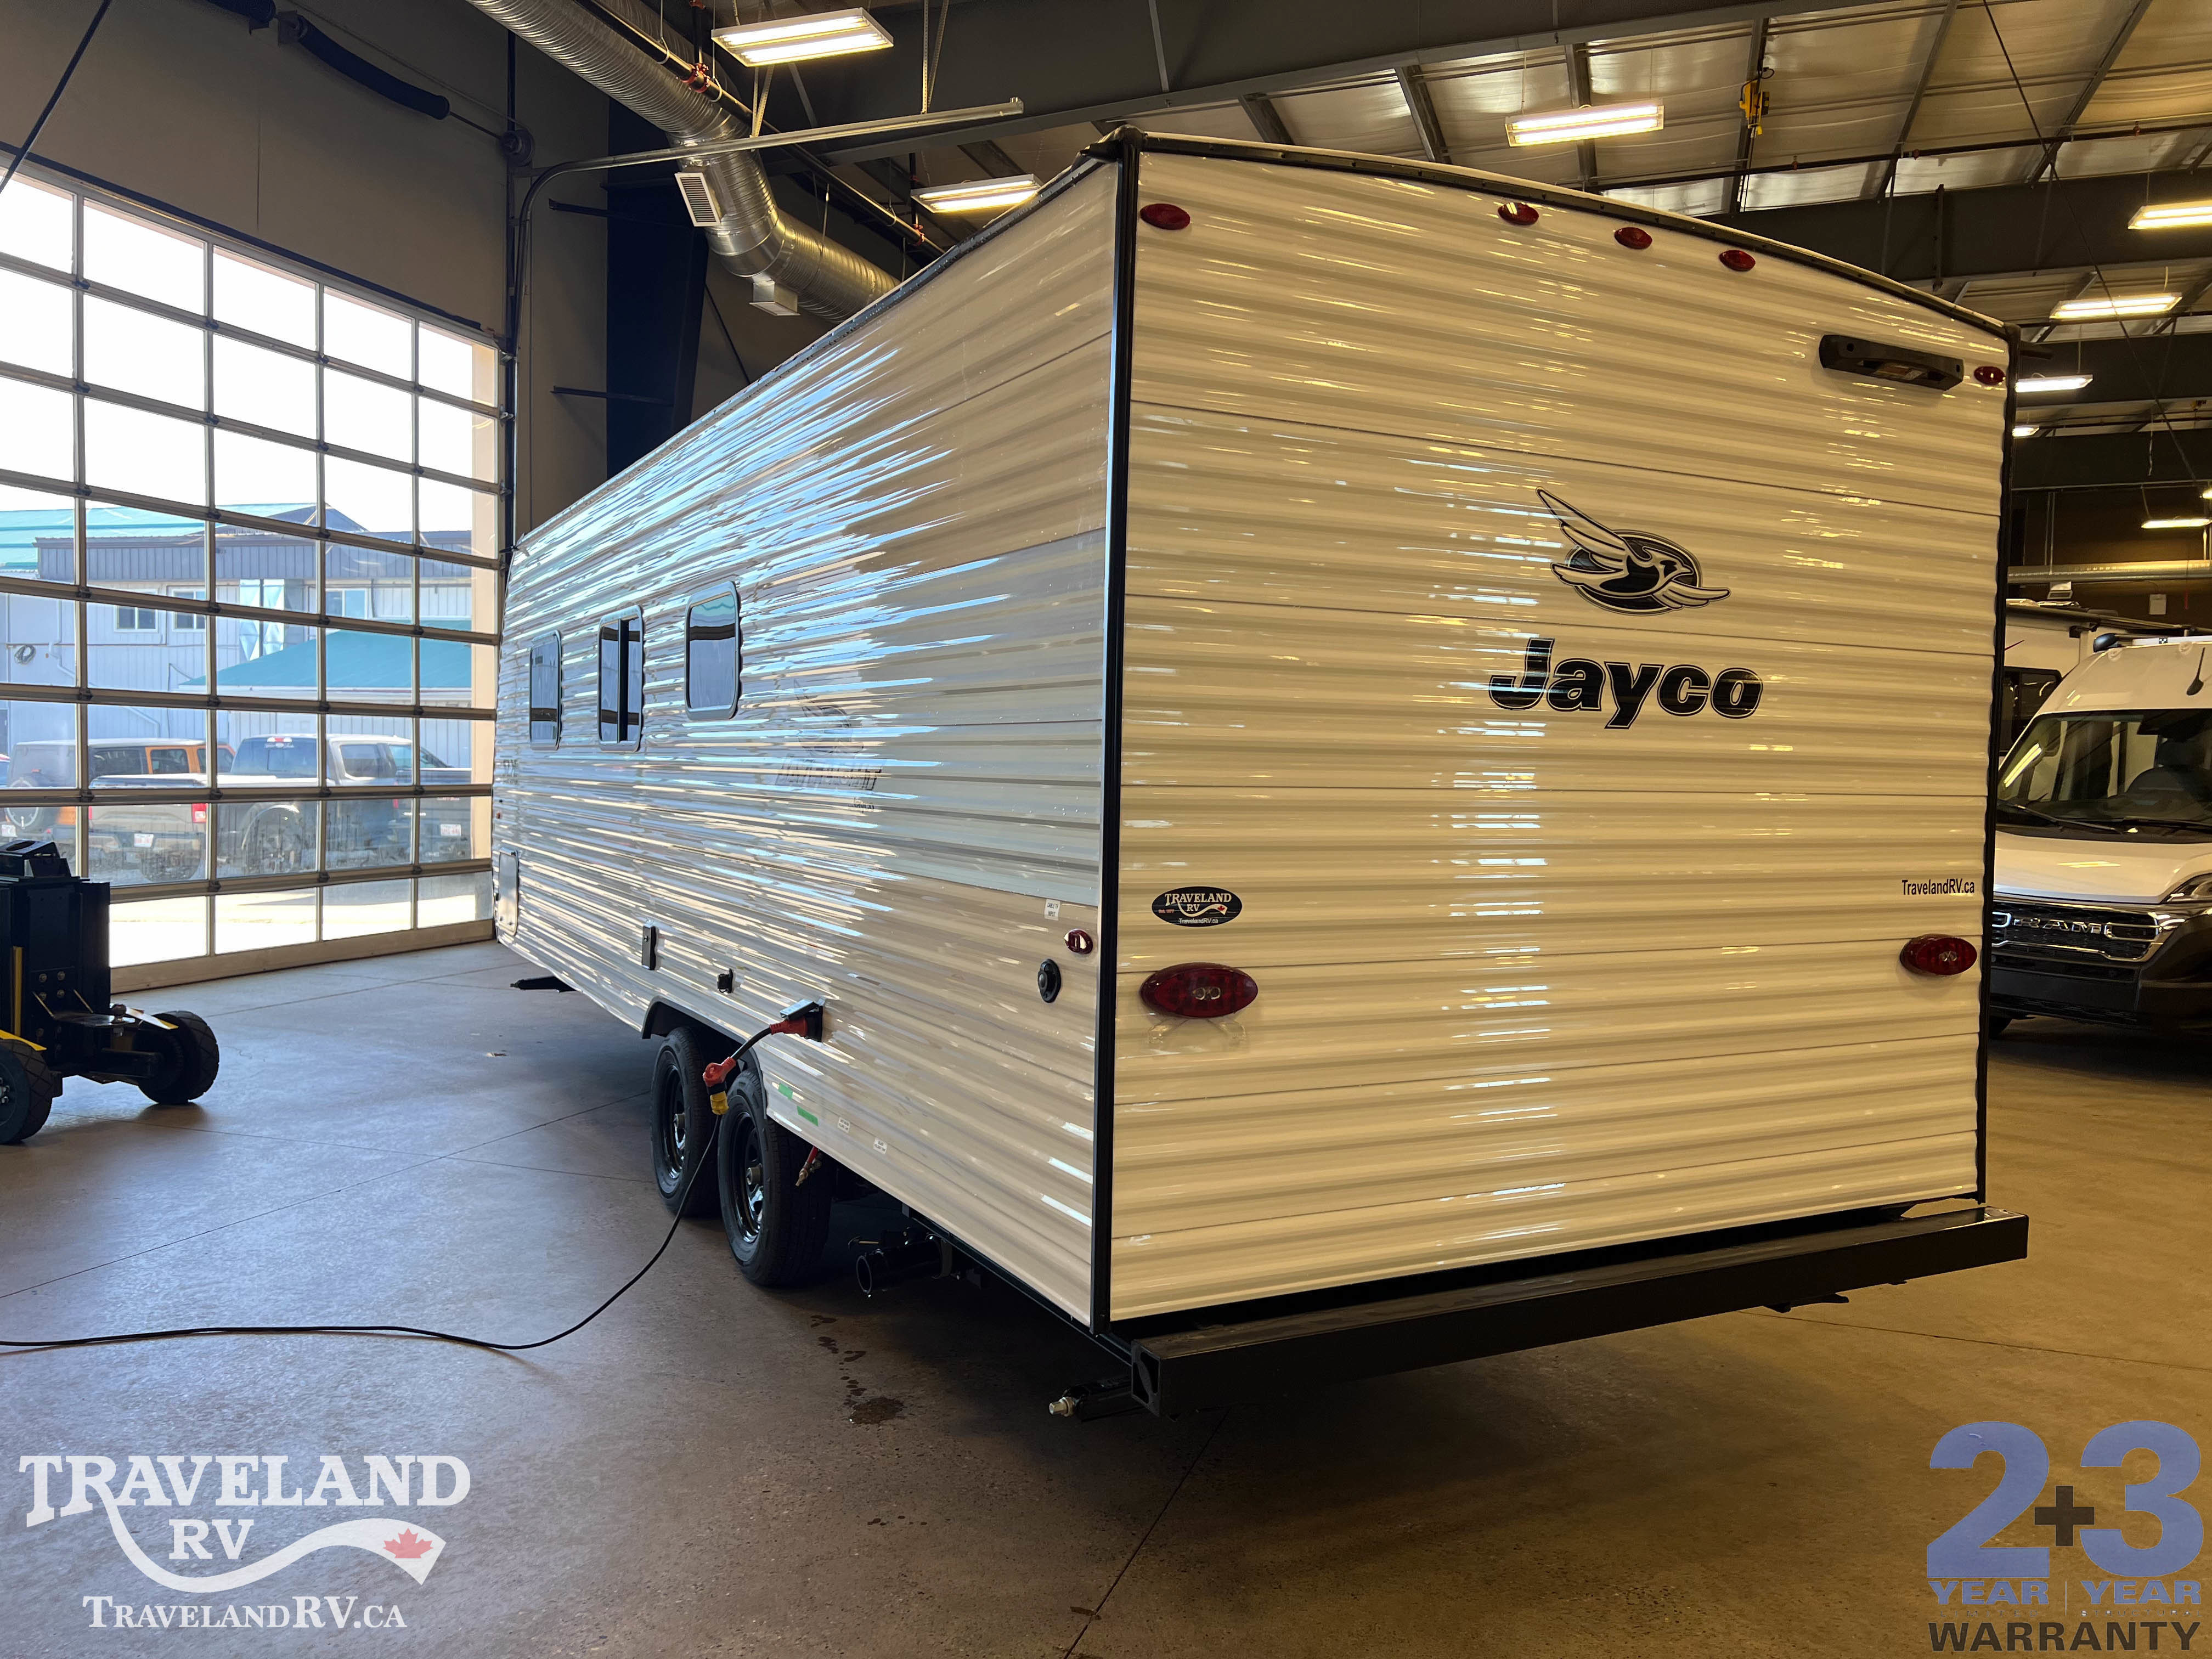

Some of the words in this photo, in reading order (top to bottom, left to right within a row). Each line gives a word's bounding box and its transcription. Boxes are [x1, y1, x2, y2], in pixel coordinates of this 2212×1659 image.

[1488, 638, 1763, 729] Jayco
[1902, 878, 1975, 895] TravelandRV.ca
[1165, 893, 1232, 906] TRAVELAND
[2013, 917, 2102, 934] RAM
